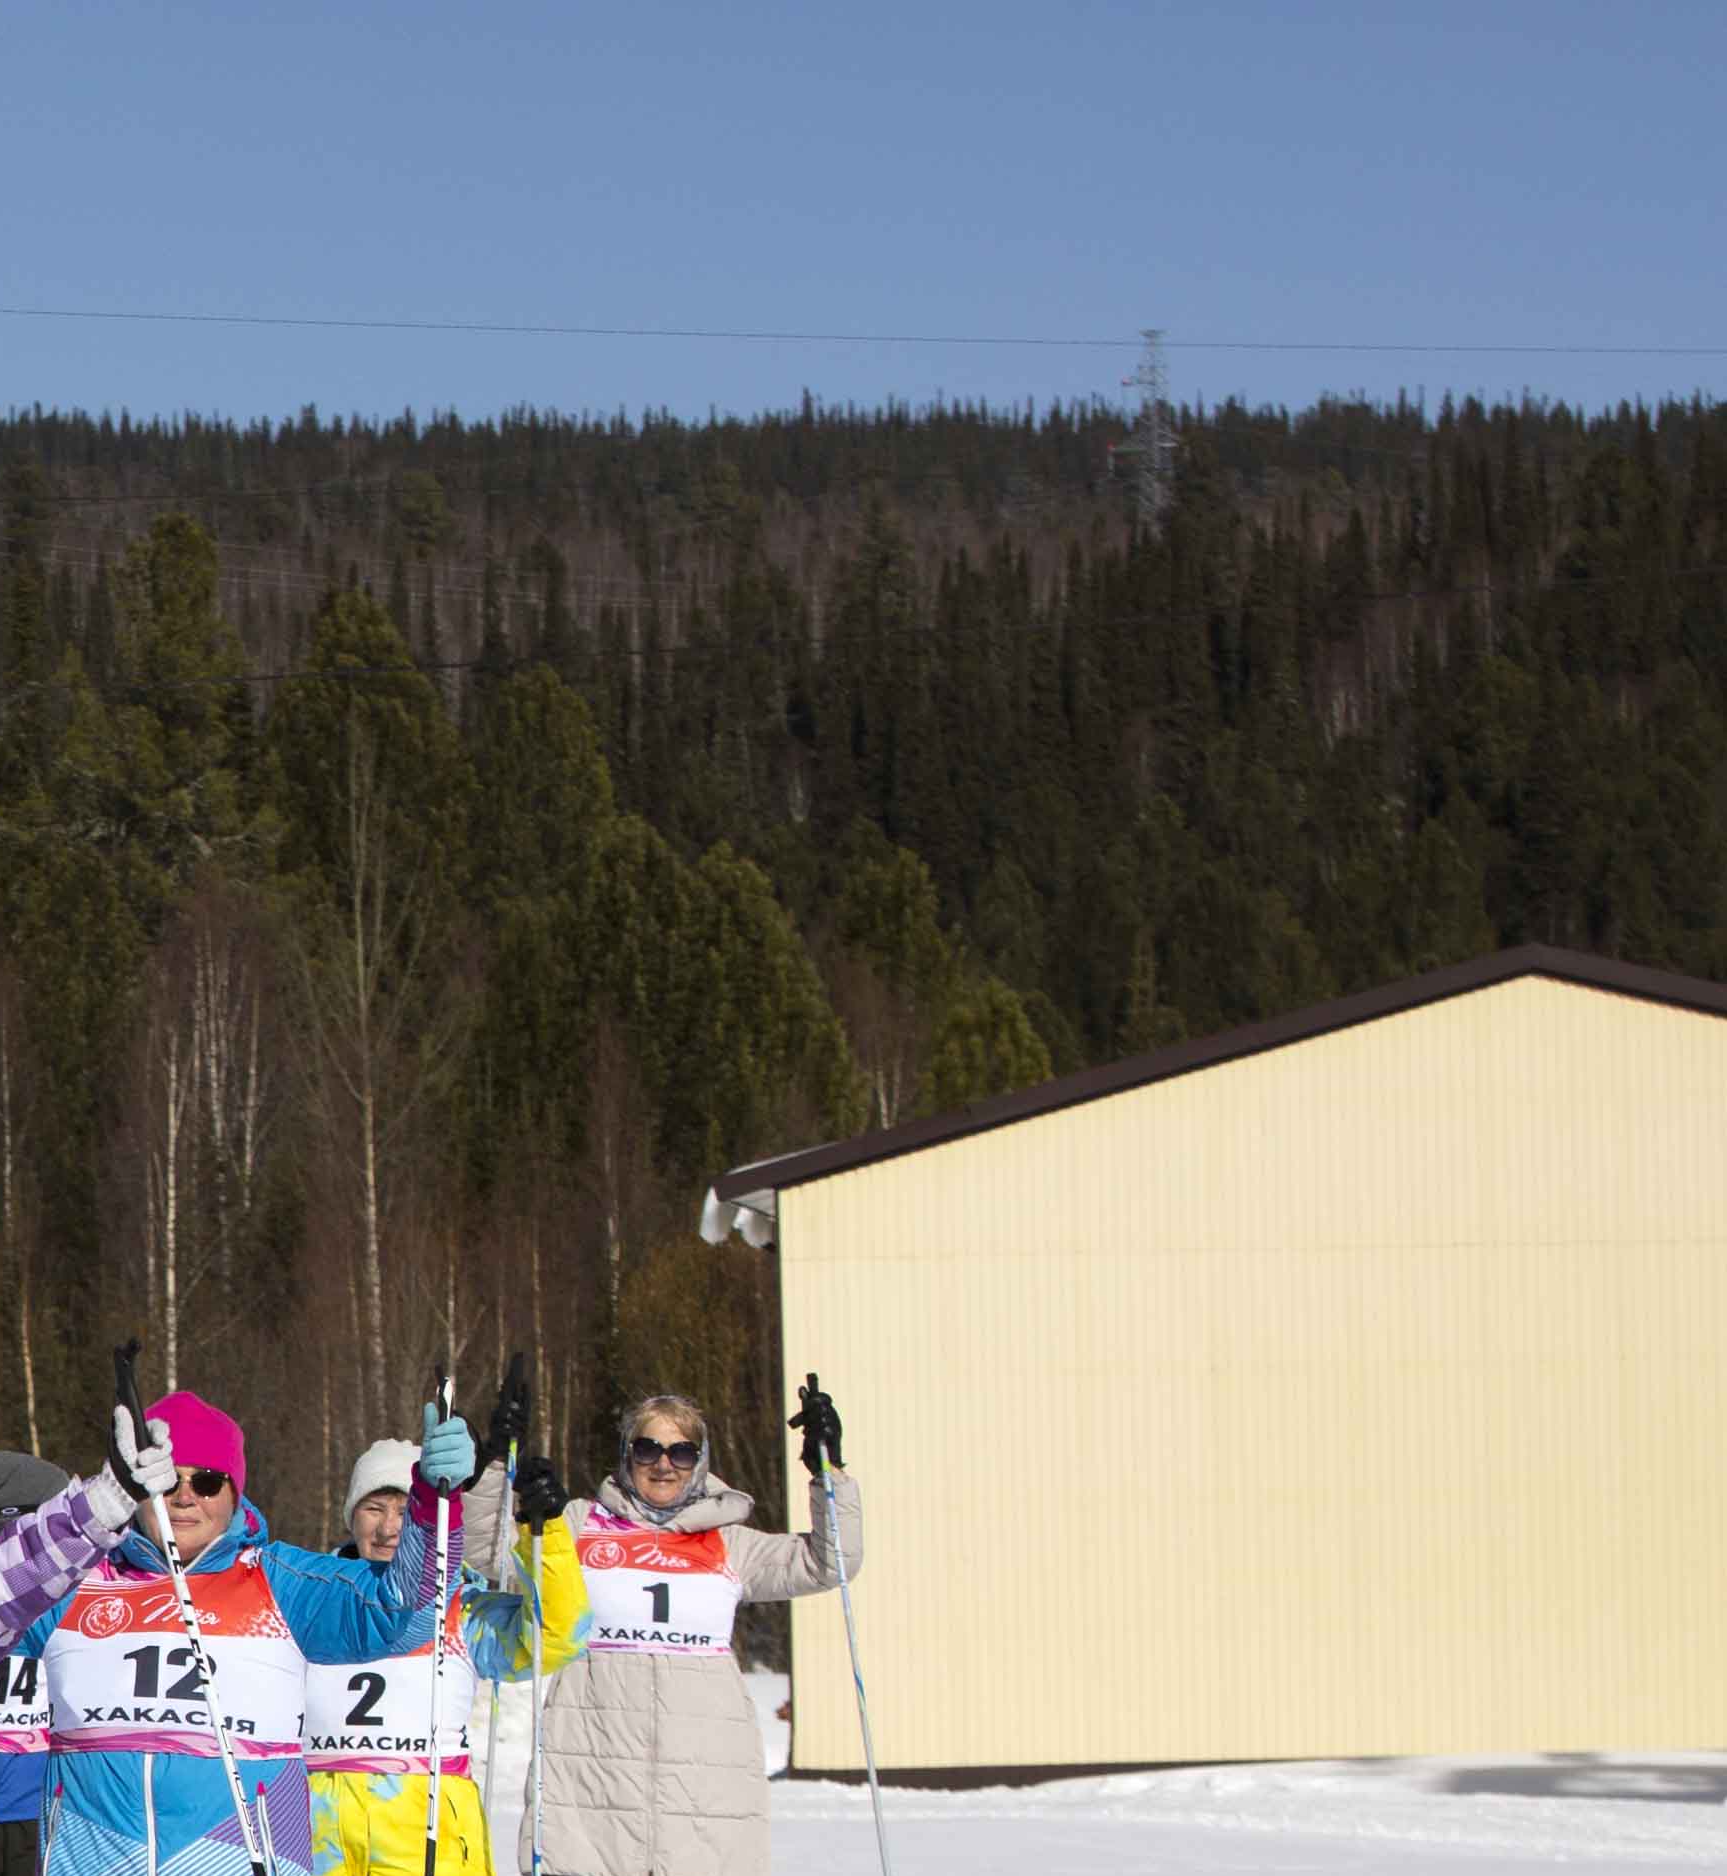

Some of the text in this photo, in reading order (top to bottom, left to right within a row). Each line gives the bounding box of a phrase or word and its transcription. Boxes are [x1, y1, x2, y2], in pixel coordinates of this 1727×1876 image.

[644, 1583, 668, 1623] 1
[600, 1627, 711, 1645] ХАКАСИЯ
[123, 1644, 217, 1701] 12
[346, 1673, 386, 1726] 2
[311, 1735, 428, 1752] ХАКАСИЯ
